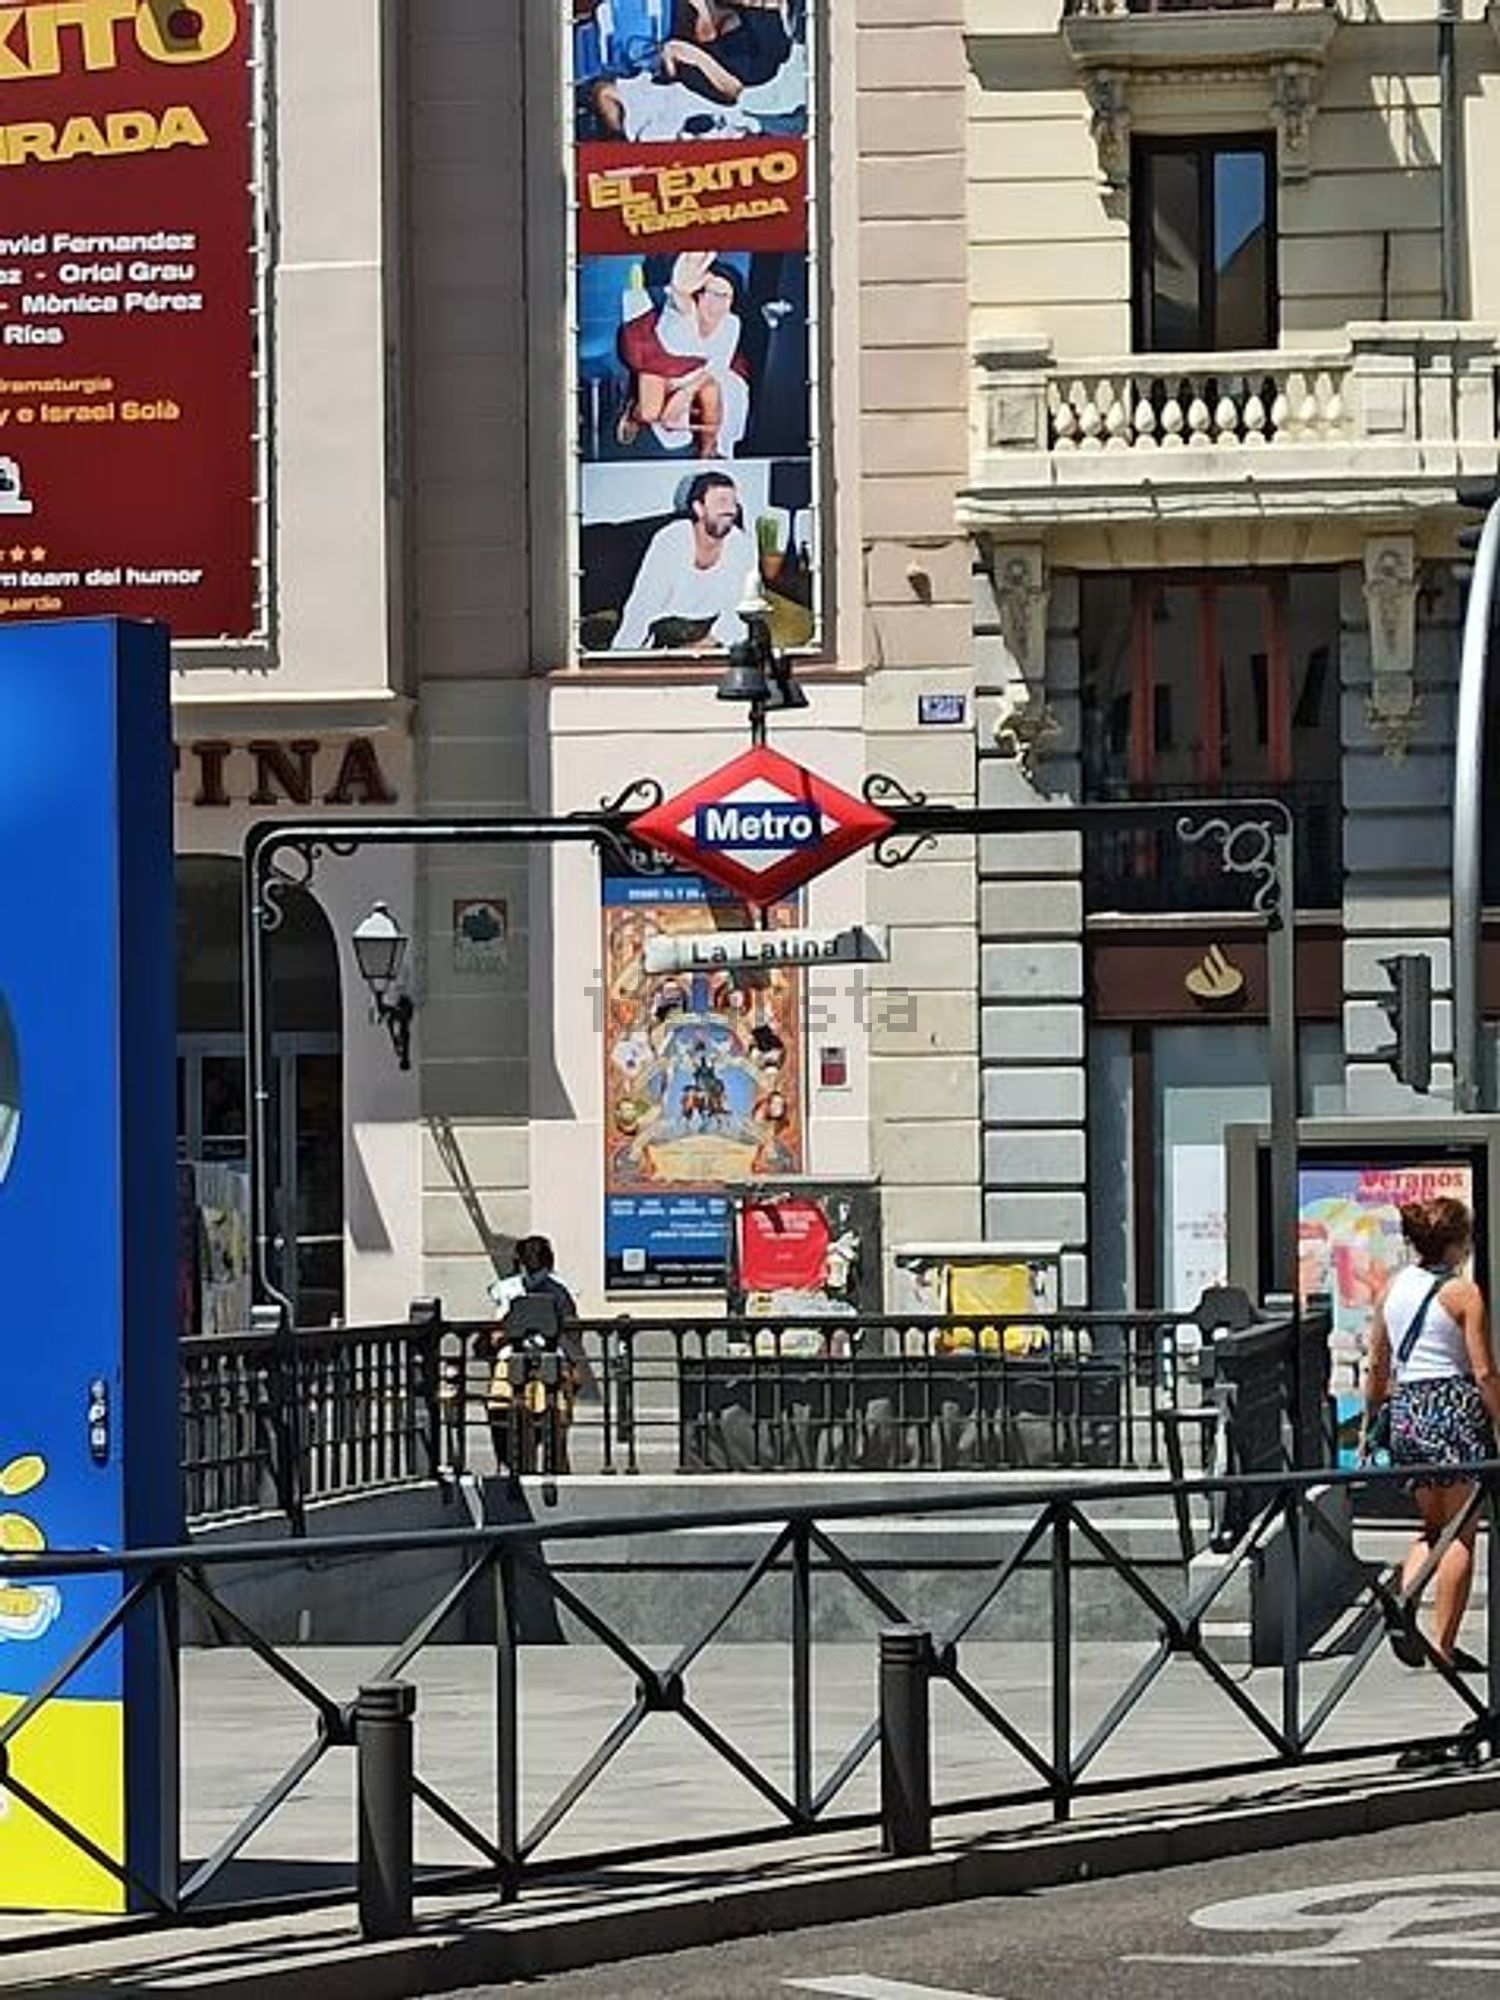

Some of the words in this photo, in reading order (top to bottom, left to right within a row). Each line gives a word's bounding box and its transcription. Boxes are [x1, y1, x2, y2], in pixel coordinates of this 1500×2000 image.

[0, 106, 209, 166] RADA
[588, 172, 651, 209] EL
[658, 152, 798, 196] ÉXITO
[53, 232, 196, 253] Fernandez
[59, 262, 123, 283] Oriol
[129, 261, 196, 281] Grau
[22, 293, 118, 314] Mònica
[125, 291, 203, 312] Pérez
[4, 324, 64, 345] Ríos
[0, 377, 113, 395] ramaturgia
[41, 402, 115, 423] Israel
[21, 570, 79, 587] team
[85, 567, 121, 586] del
[126, 566, 203, 585] humor
[174, 737, 399, 807] INA
[706, 808, 813, 840] Metro
[691, 941, 728, 964] La
[741, 931, 838, 961] Latina
